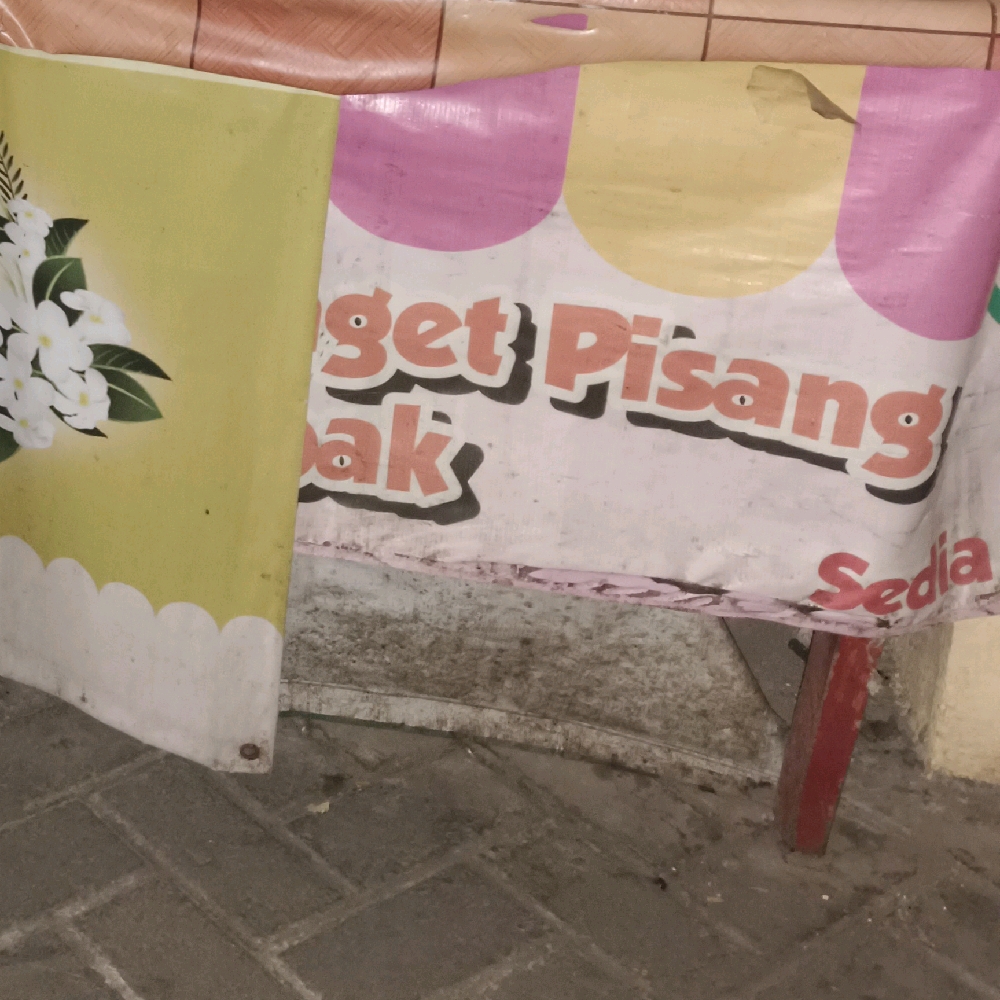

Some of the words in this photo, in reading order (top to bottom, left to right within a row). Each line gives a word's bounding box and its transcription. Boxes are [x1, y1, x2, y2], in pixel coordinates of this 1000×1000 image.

[313, 289, 507, 378] get
[545, 304, 945, 478] Pisang
[809, 530, 993, 615] Sedia
